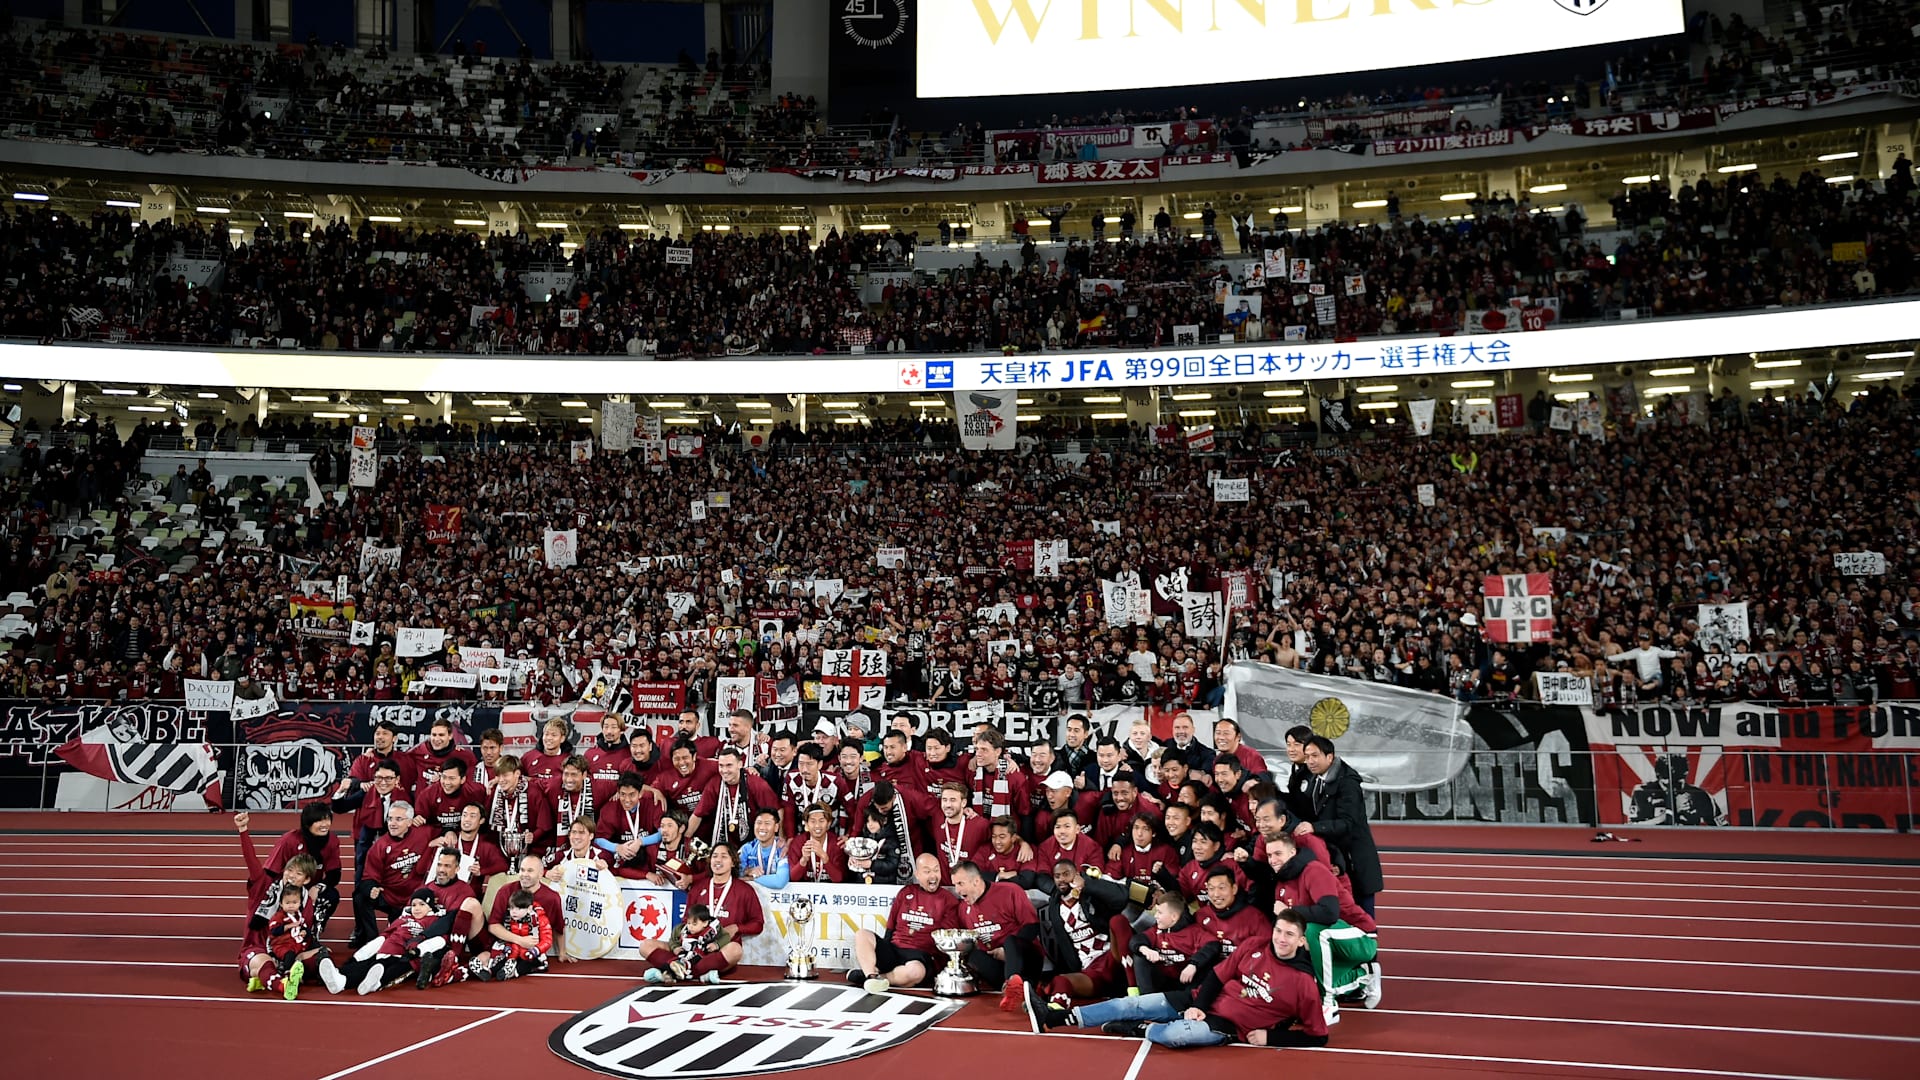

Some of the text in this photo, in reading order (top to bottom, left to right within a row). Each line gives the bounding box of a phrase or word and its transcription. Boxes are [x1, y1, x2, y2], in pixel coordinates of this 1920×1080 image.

[845, 0, 865, 13] 45
[148, 202, 164, 210] 255
[171, 264, 188, 272] 255
[528, 277, 545, 285] 254
[1526, 316, 1541, 330] 10
[980, 343, 1512, 383] 天皇杯 JFA 第99回全日本サッカー選手権大会
[576, 513, 587, 528] 16
[1507, 578, 1523, 594] K
[672, 595, 687, 608] 27
[1085, 594, 1093, 608] 8
[1487, 597, 1546, 618] V C
[1188, 597, 1219, 630] 誇
[403, 631, 425, 640] 前川
[1512, 619, 1526, 639] F
[619, 658, 644, 681] 13
[827, 655, 885, 677] 最強
[188, 683, 230, 694] DAVID
[1542, 676, 1586, 690] 田中順也の
[637, 694, 665, 702] THOMAS
[759, 677, 777, 708] 5
[826, 689, 883, 709] 神戸
[187, 698, 229, 708] VILLA
[638, 702, 678, 710] VERMAELEN
[1611, 708, 1720, 737] NOW
[1736, 711, 1820, 738] and
[1744, 750, 1771, 783] IN
[1780, 751, 1830, 785] THE
[770, 892, 802, 904] 天皇杯
[565, 895, 603, 919] 優勝
[688, 1013, 894, 1033] VISSEL
